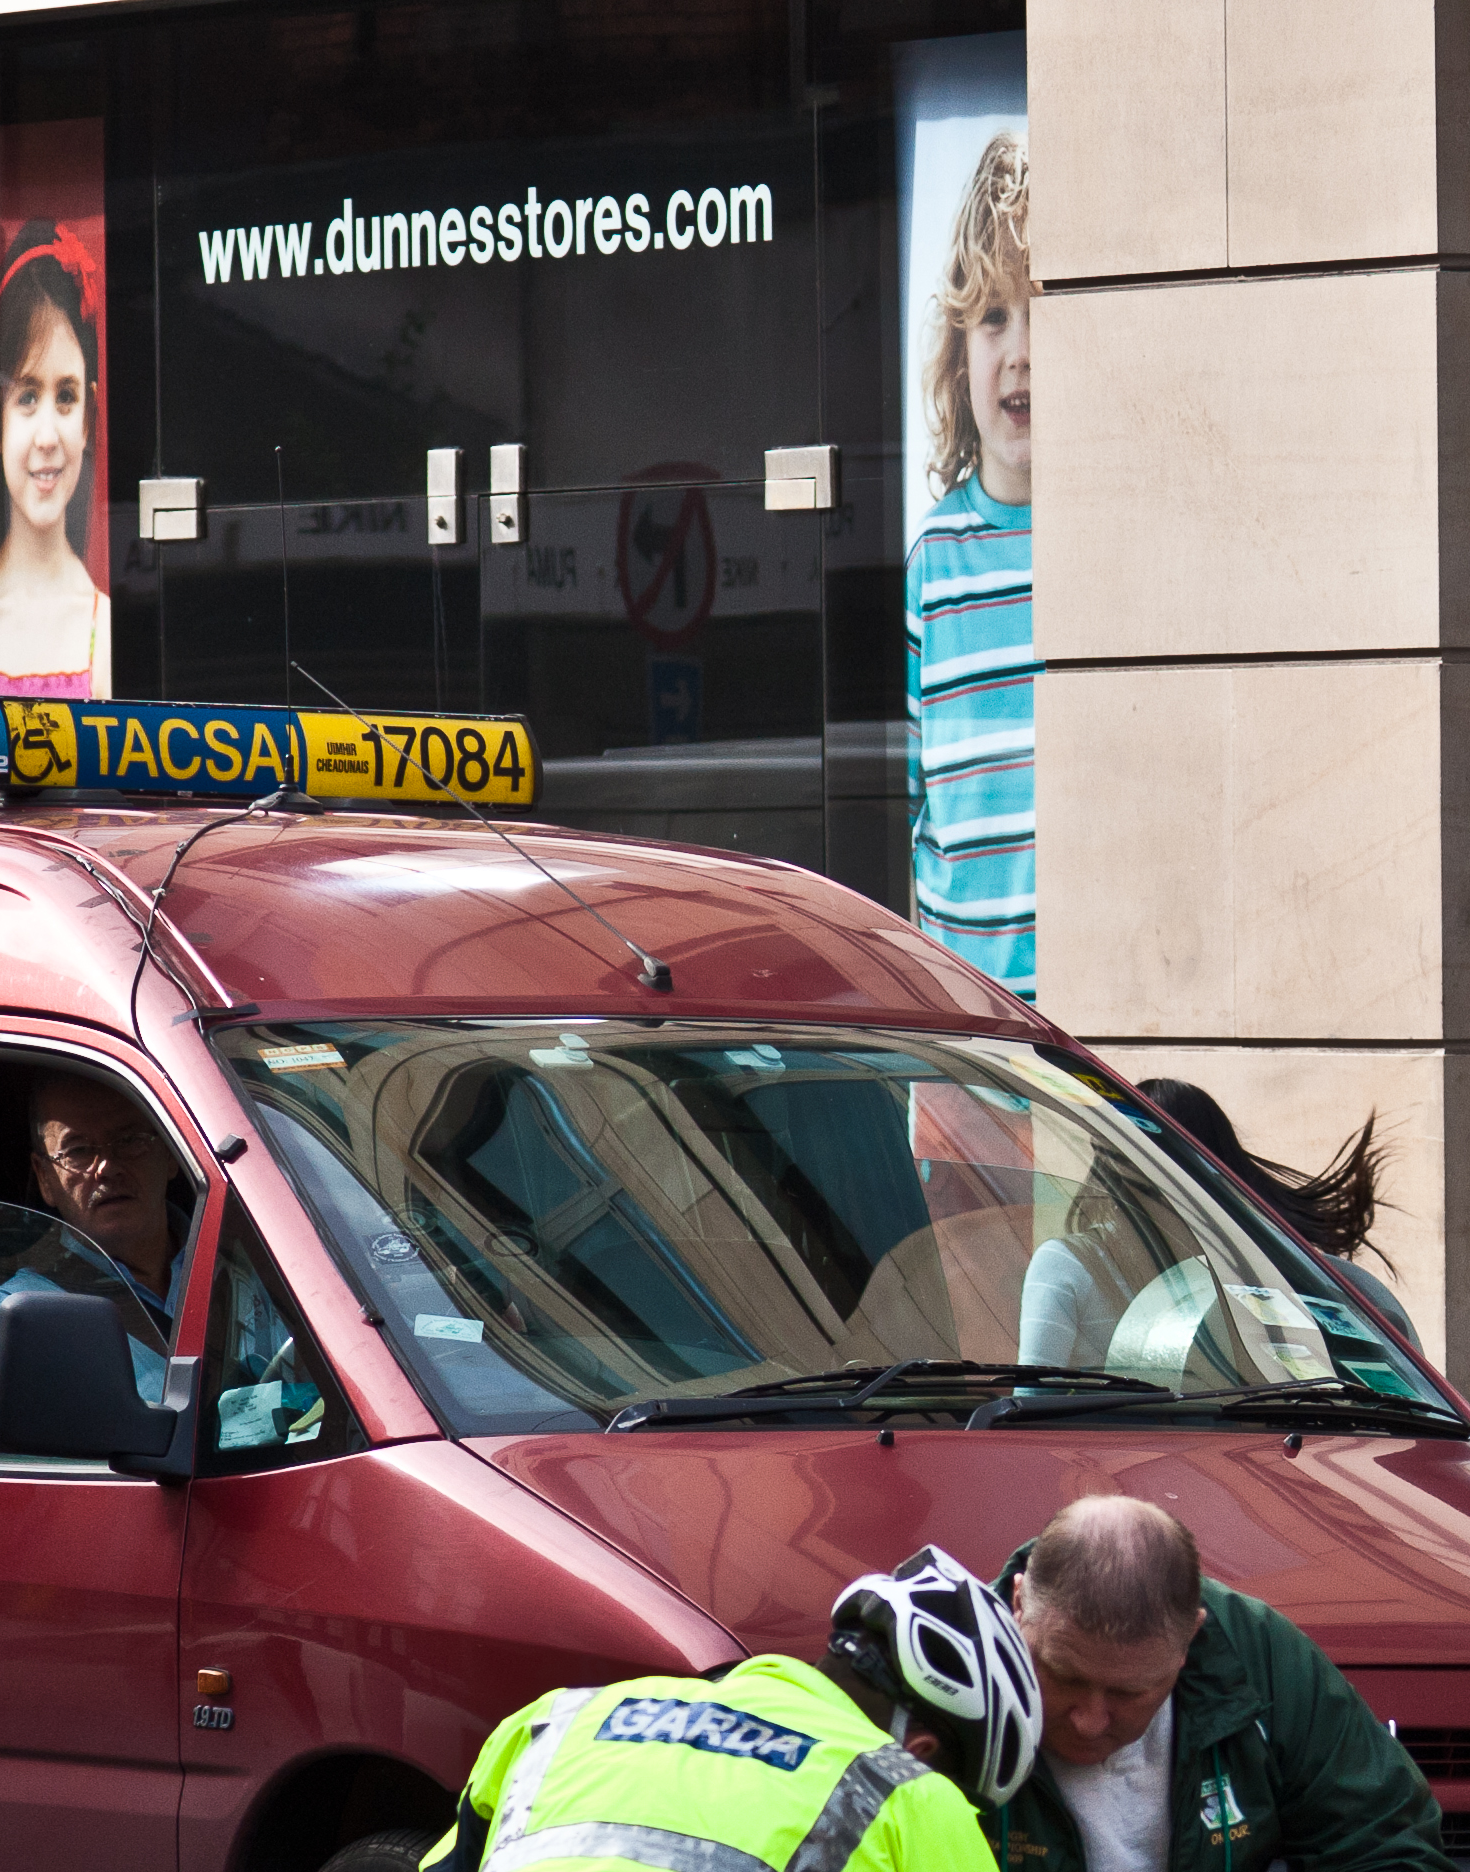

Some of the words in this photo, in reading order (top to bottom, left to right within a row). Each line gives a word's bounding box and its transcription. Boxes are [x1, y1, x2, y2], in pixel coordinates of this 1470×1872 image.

[198, 183, 774, 284] www.dunnesstores.com
[316, 757, 369, 774] CHEADUNAIS
[361, 723, 526, 792] 17084
[610, 1700, 804, 1766] GARDA
[1228, 1824, 1251, 1840] OUR
